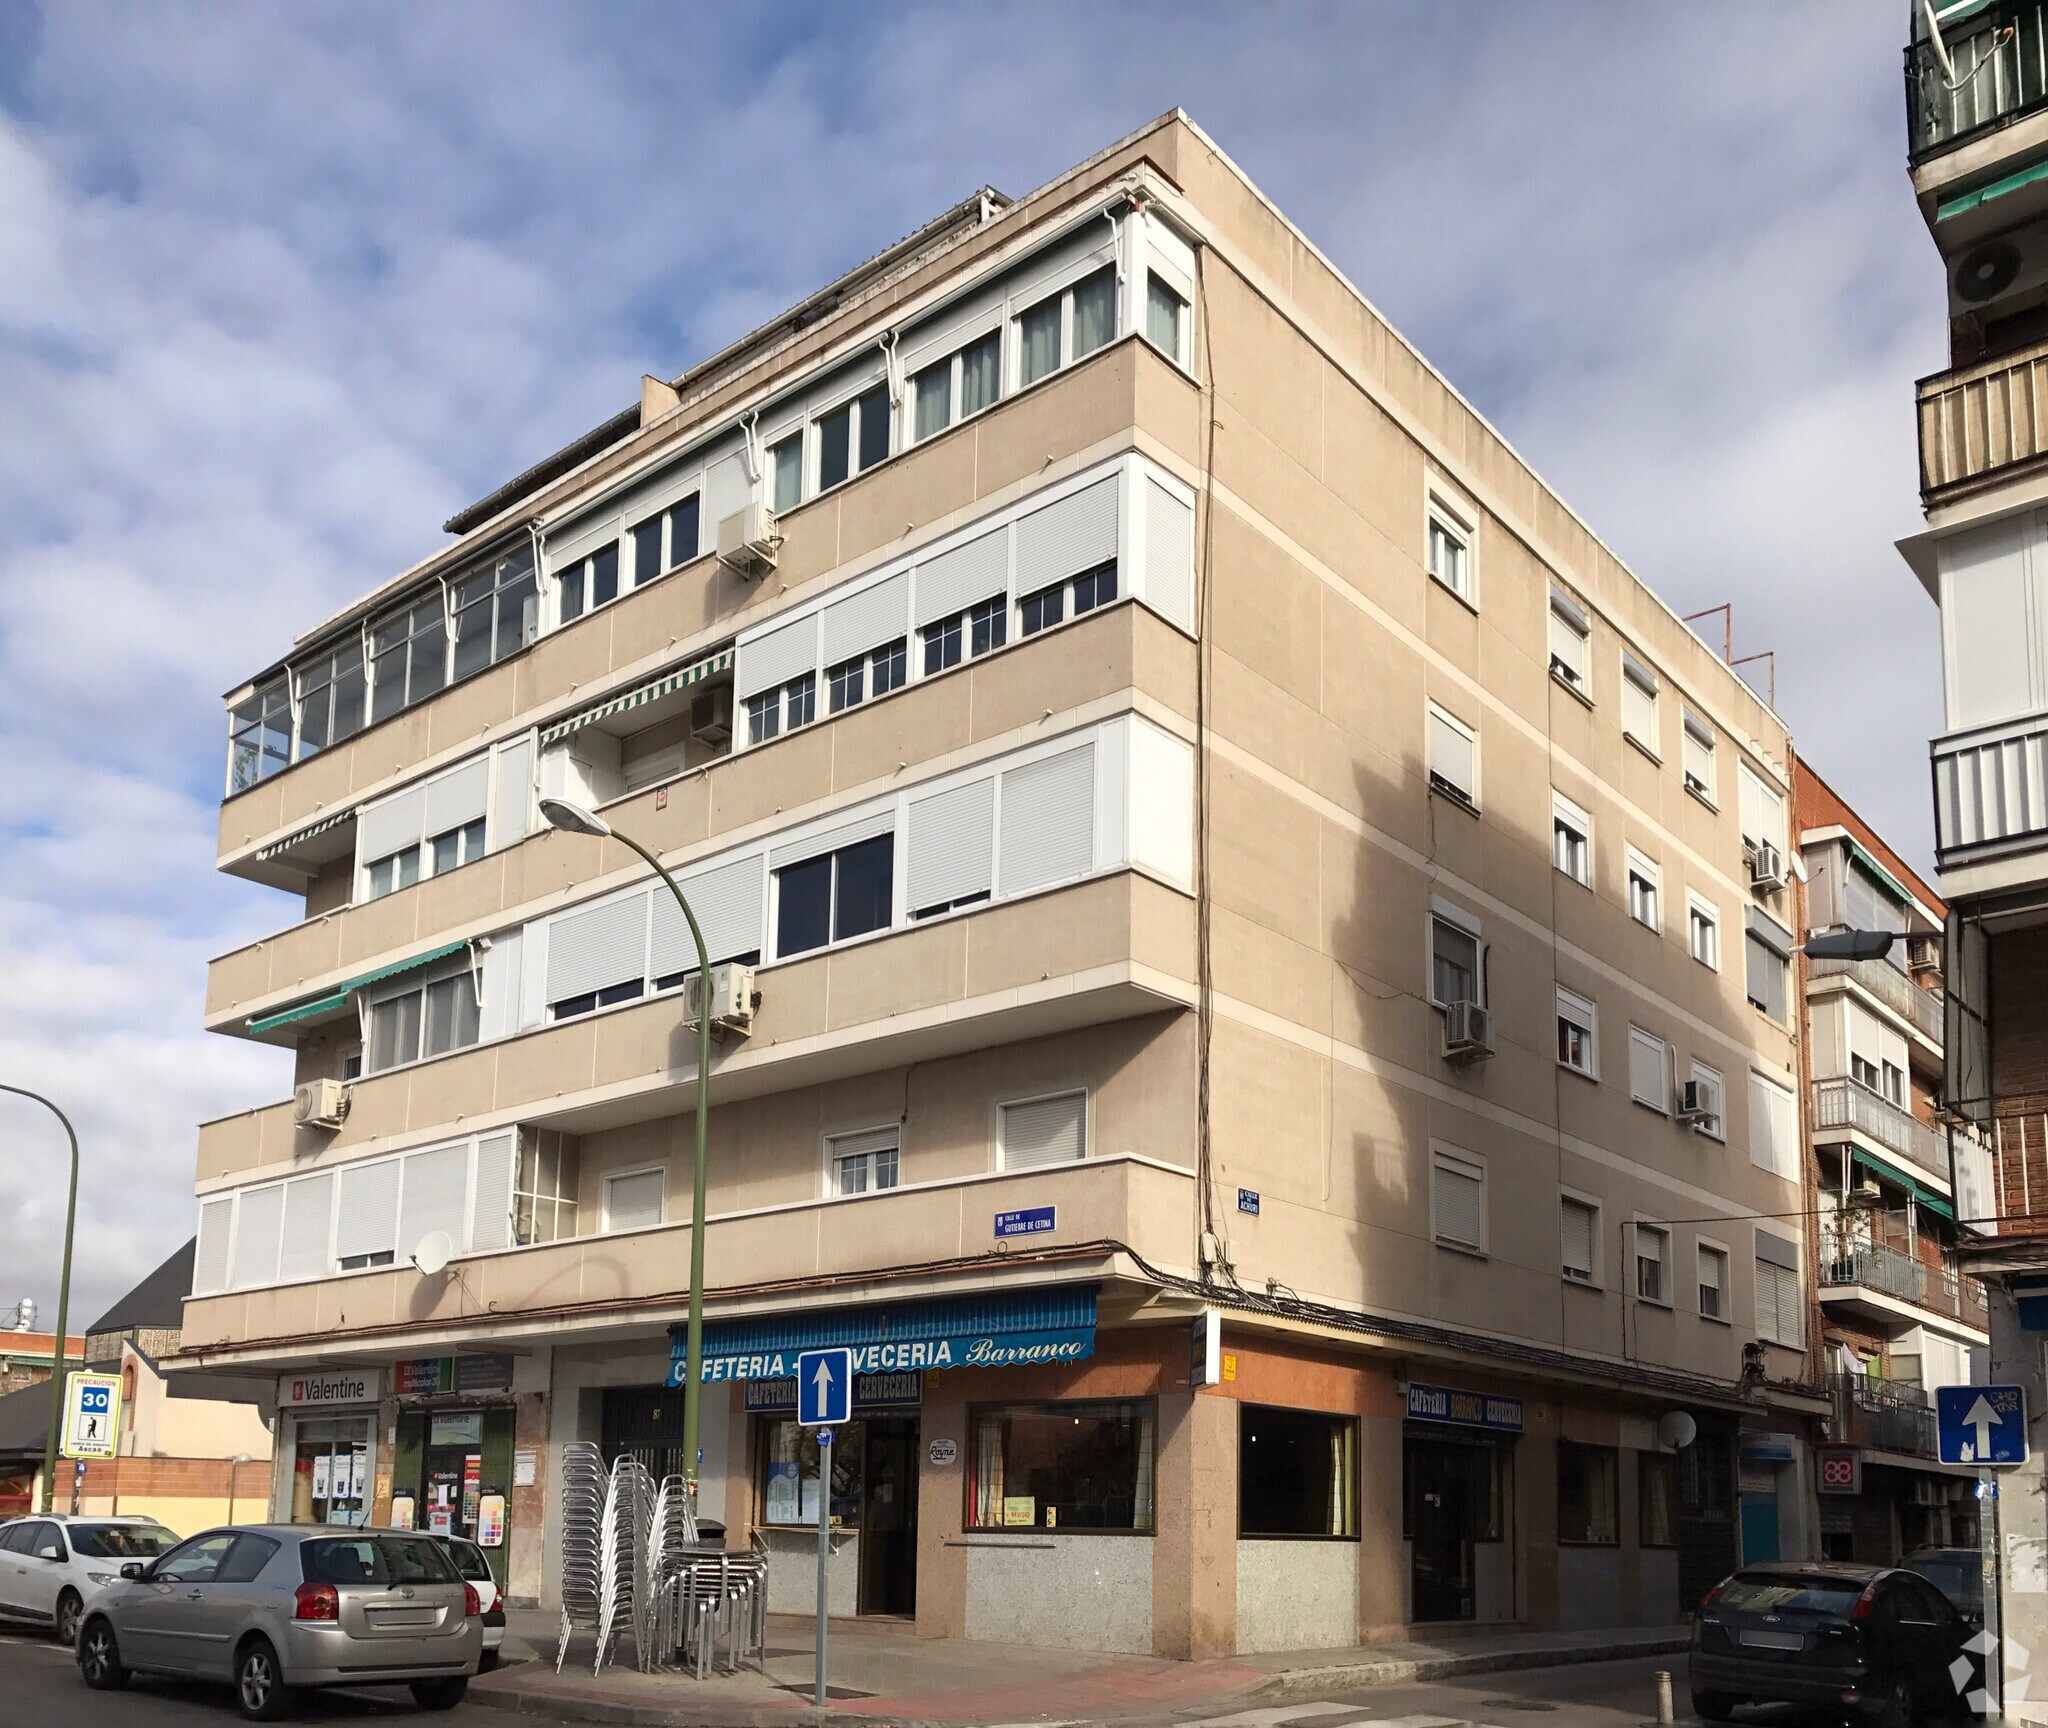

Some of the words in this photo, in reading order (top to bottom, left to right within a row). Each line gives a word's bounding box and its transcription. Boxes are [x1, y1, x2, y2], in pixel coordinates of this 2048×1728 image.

[1004, 1214, 1015, 1222] CALLE
[1027, 1220, 1034, 1230] DE
[1034, 1218, 1052, 1229] CETINA
[674, 1354, 785, 1381] CFETERIA
[851, 1340, 952, 1370] VECERIA
[965, 1338, 1087, 1362] Barranco
[410, 1364, 441, 1376] Valentine
[76, 1378, 116, 1387] PRECAUCION
[305, 1377, 364, 1400] Valentine
[748, 1380, 797, 1405] CAFETERIA
[859, 1374, 918, 1400] CERVECERIA
[83, 1393, 108, 1407] 30
[1410, 1388, 1447, 1415] CAFETERIA
[1486, 1400, 1522, 1425] CERVECERIA
